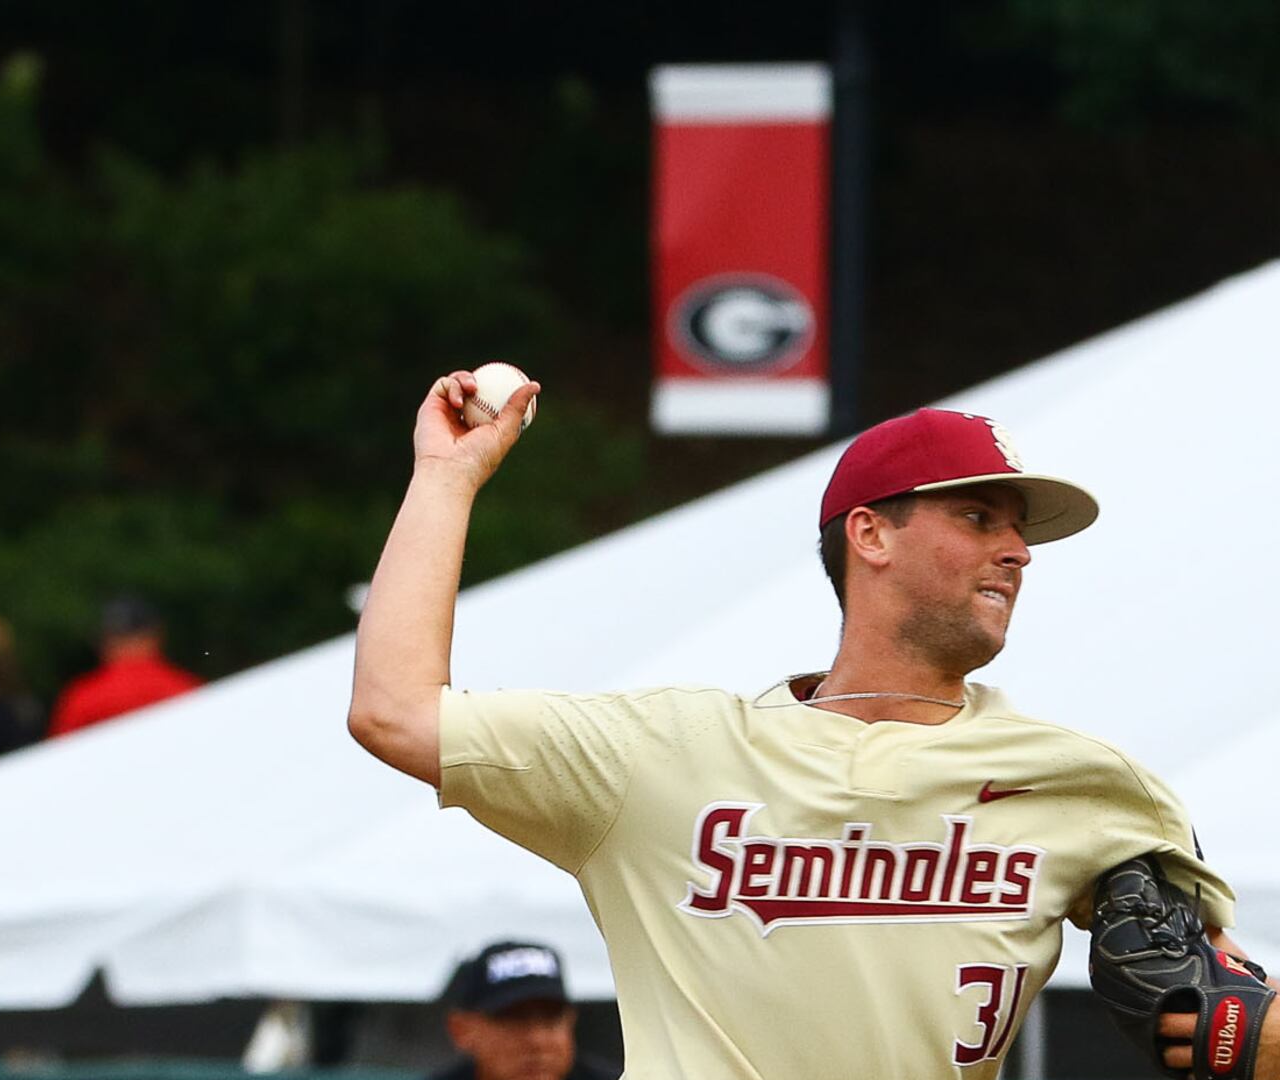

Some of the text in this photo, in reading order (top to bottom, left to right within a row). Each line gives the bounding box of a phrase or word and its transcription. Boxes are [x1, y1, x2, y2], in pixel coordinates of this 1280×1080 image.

[677, 800, 1047, 934] Seminoles
[951, 962, 1029, 1067] 31
[1214, 1003, 1241, 1067] Wilson
